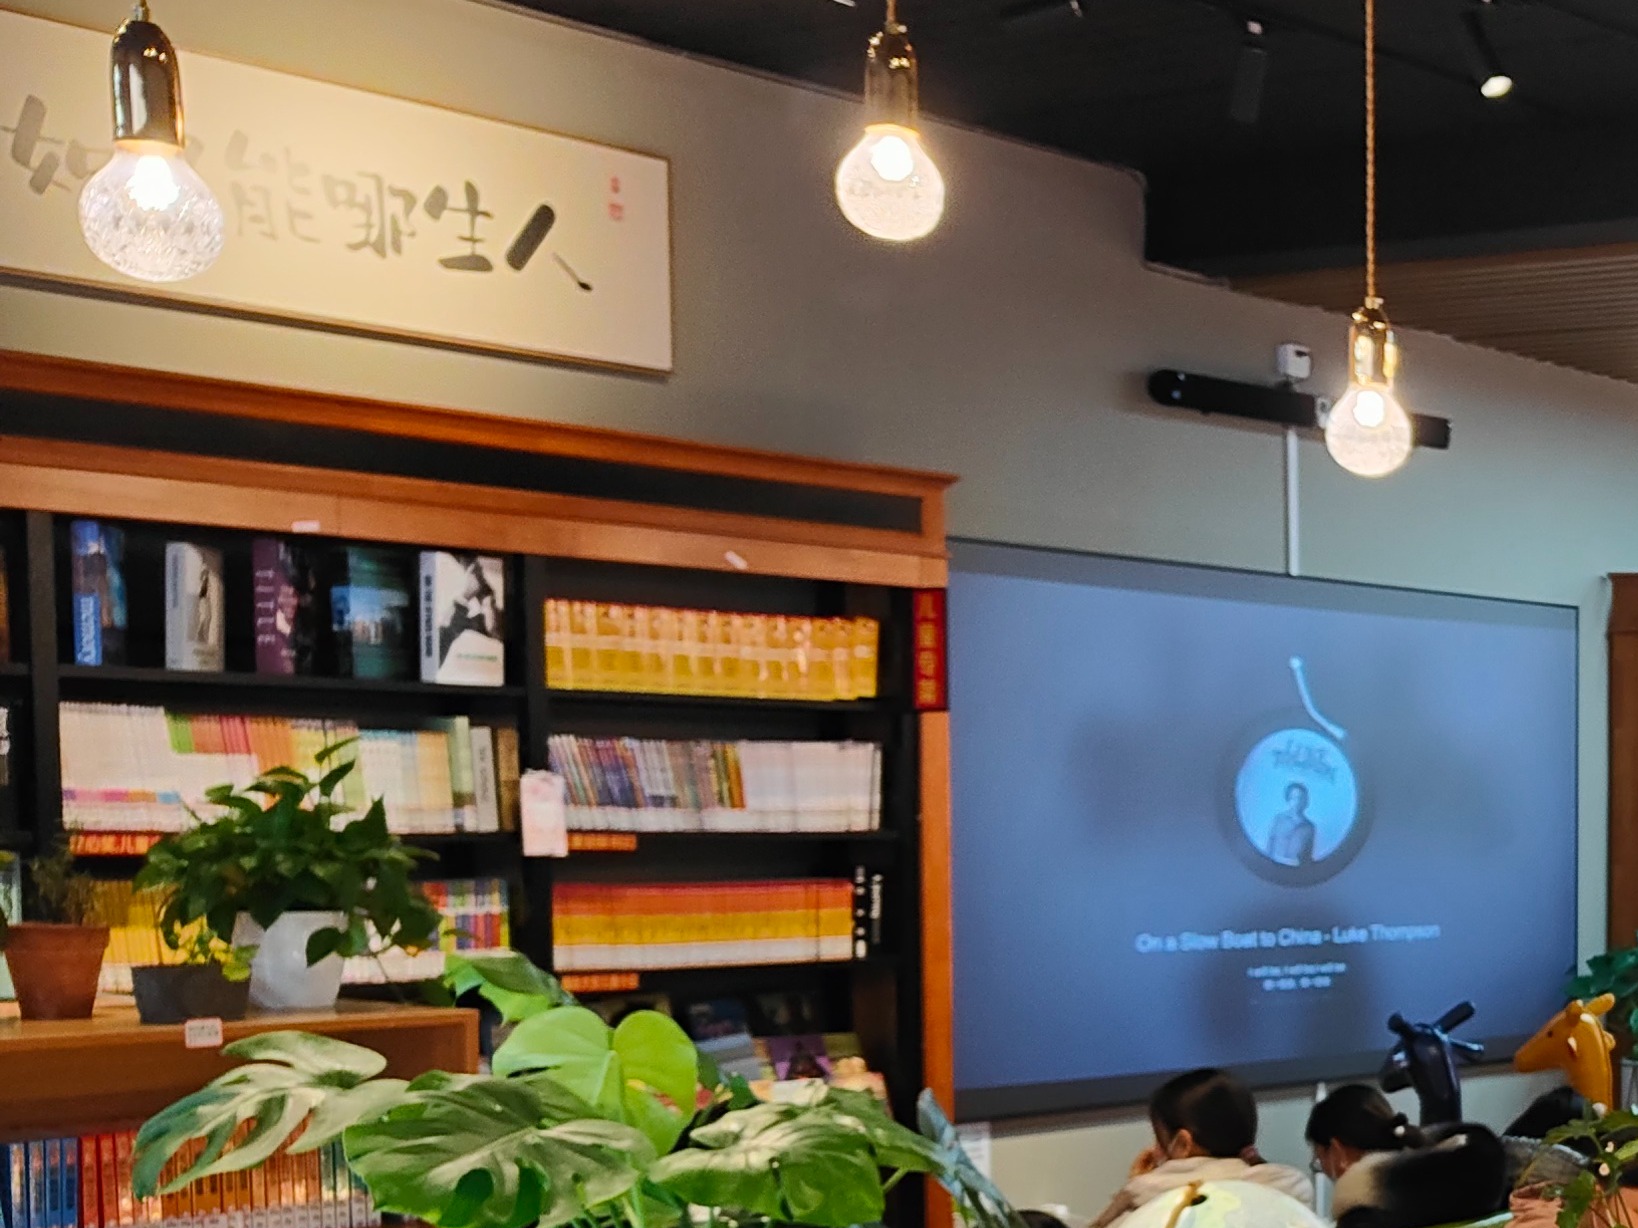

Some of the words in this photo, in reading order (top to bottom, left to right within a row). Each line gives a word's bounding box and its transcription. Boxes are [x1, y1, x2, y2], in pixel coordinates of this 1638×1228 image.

[1135, 933, 1162, 952] On
[1259, 931, 1276, 947] to
[1277, 927, 1322, 946] China
[1332, 926, 1368, 943] Luke
[1369, 923, 1441, 942] Thompson
